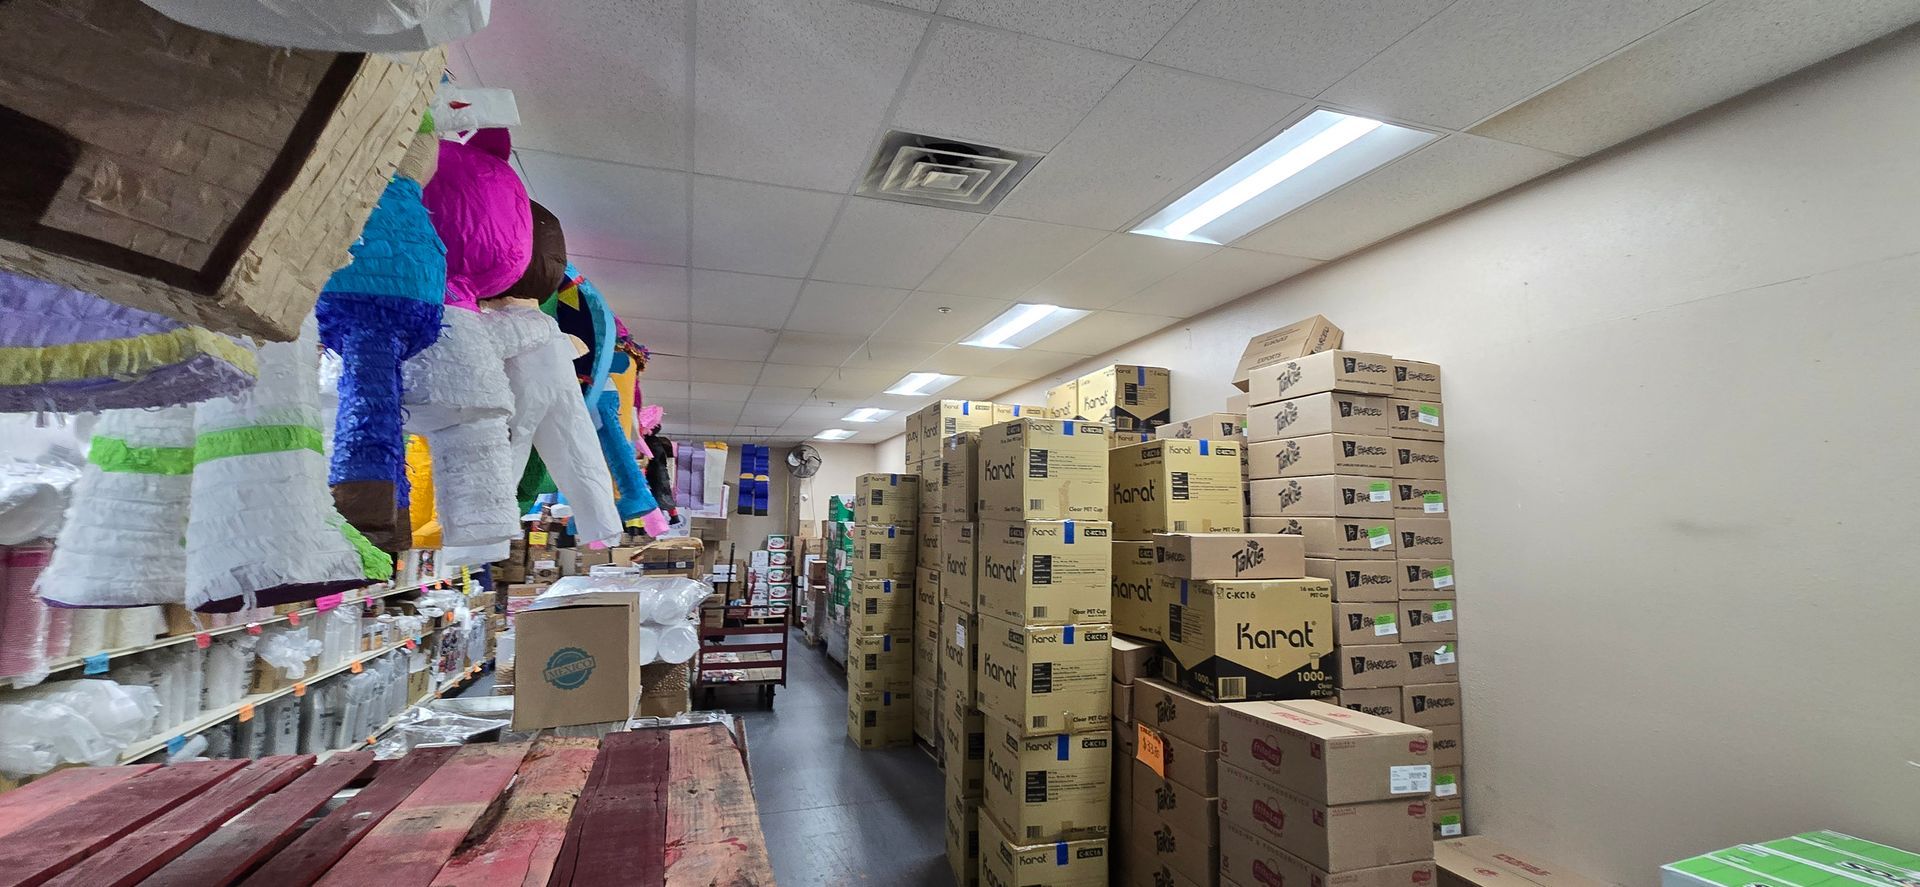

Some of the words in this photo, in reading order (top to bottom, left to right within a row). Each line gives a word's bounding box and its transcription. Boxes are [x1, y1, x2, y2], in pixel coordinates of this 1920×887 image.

[984, 457, 1015, 481] Karat
[1113, 479, 1155, 504] Karat
[1032, 527, 1056, 536] Karat
[1415, 536, 1444, 545] BARCEL
[947, 552, 966, 576] Karat
[1232, 547, 1264, 577] Takis
[985, 556, 1017, 583] Karat
[1361, 575, 1392, 584] BARCEL
[1112, 577, 1152, 602] Karat
[1226, 591, 1256, 600] C-KC16
[1032, 634, 1057, 643] Karat
[1086, 633, 1107, 641] C-KC16
[1237, 621, 1314, 650] Karat
[548, 660, 593, 679] MEXICO
[1366, 660, 1397, 669] BARCEL
[984, 653, 1017, 690] Karat
[1297, 671, 1324, 682] 1000
[1426, 698, 1455, 707] BARCEL
[1155, 701, 1176, 725] Takis
[1025, 742, 1053, 751] Karat
[1083, 740, 1107, 748] C-KC16
[989, 751, 1013, 795] Karat
[1019, 855, 1046, 865] Karat
